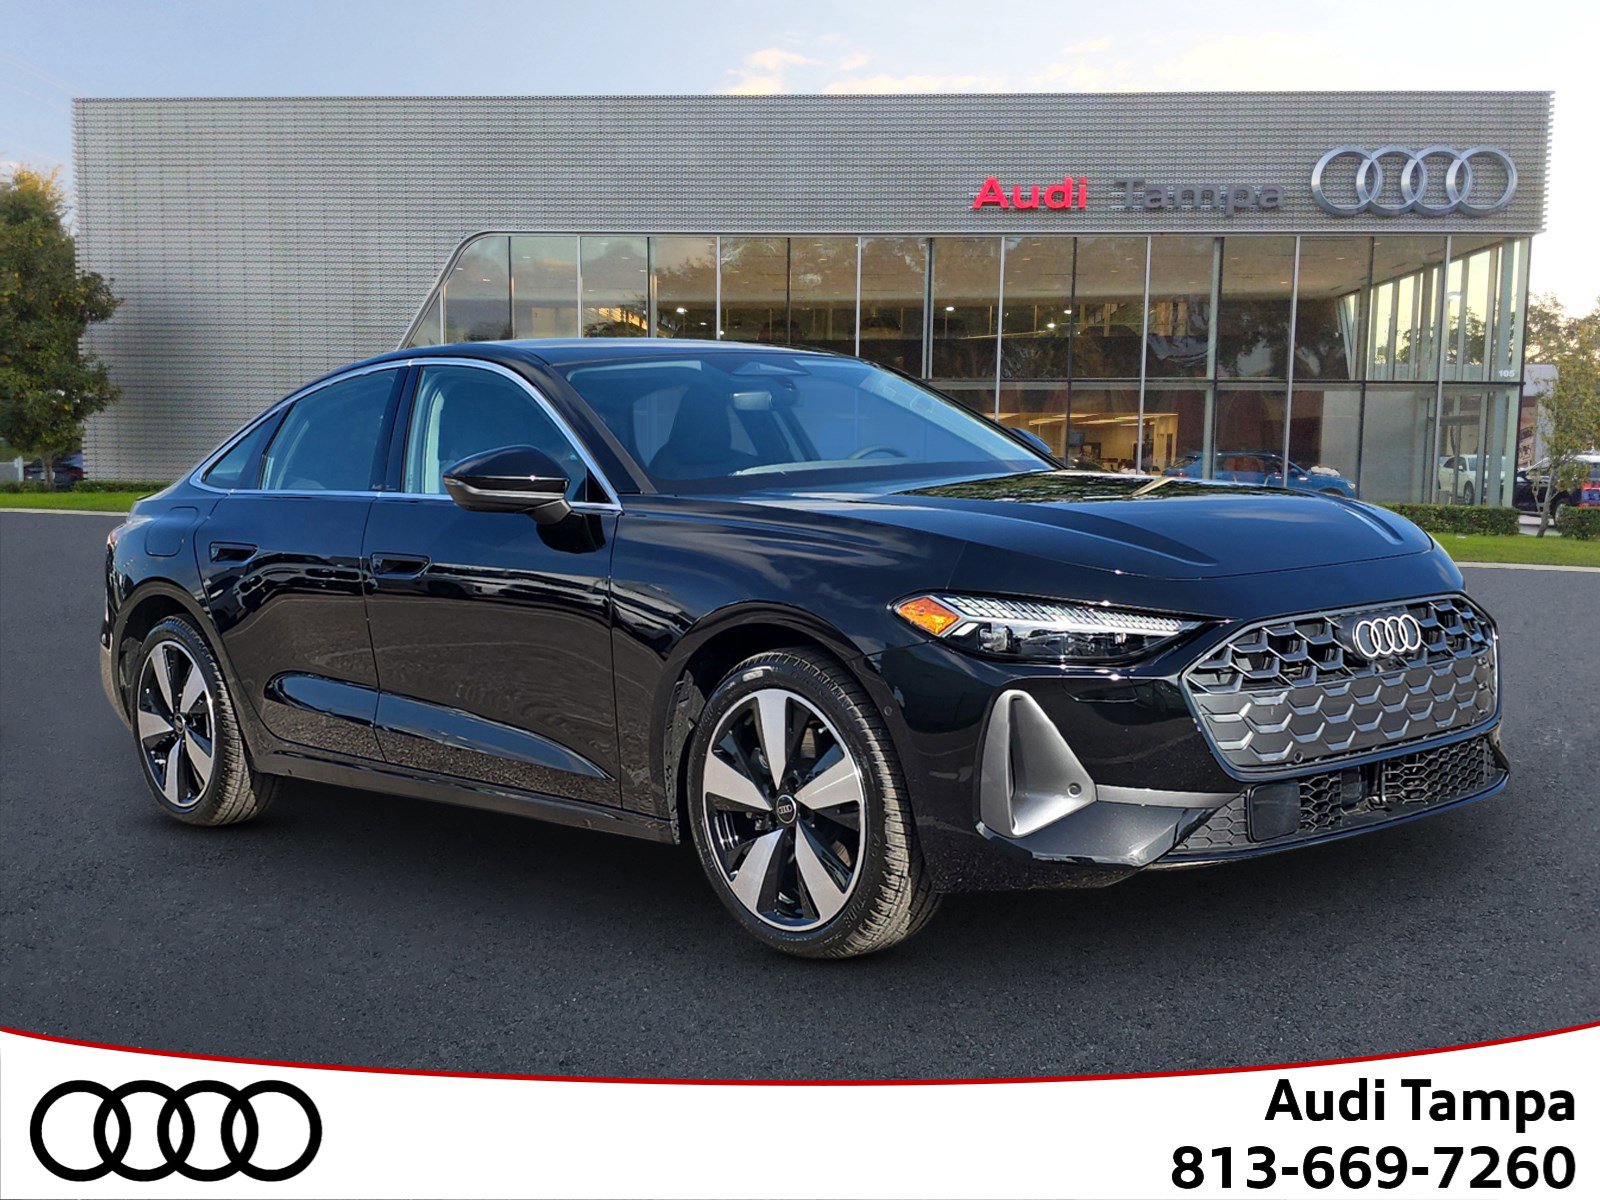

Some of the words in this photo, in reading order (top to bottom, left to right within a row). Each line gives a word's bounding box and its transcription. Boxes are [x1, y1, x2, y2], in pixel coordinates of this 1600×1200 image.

[972, 176, 1088, 211] Audi
[1114, 177, 1284, 218] Tampa
[1498, 369, 1515, 378] 105
